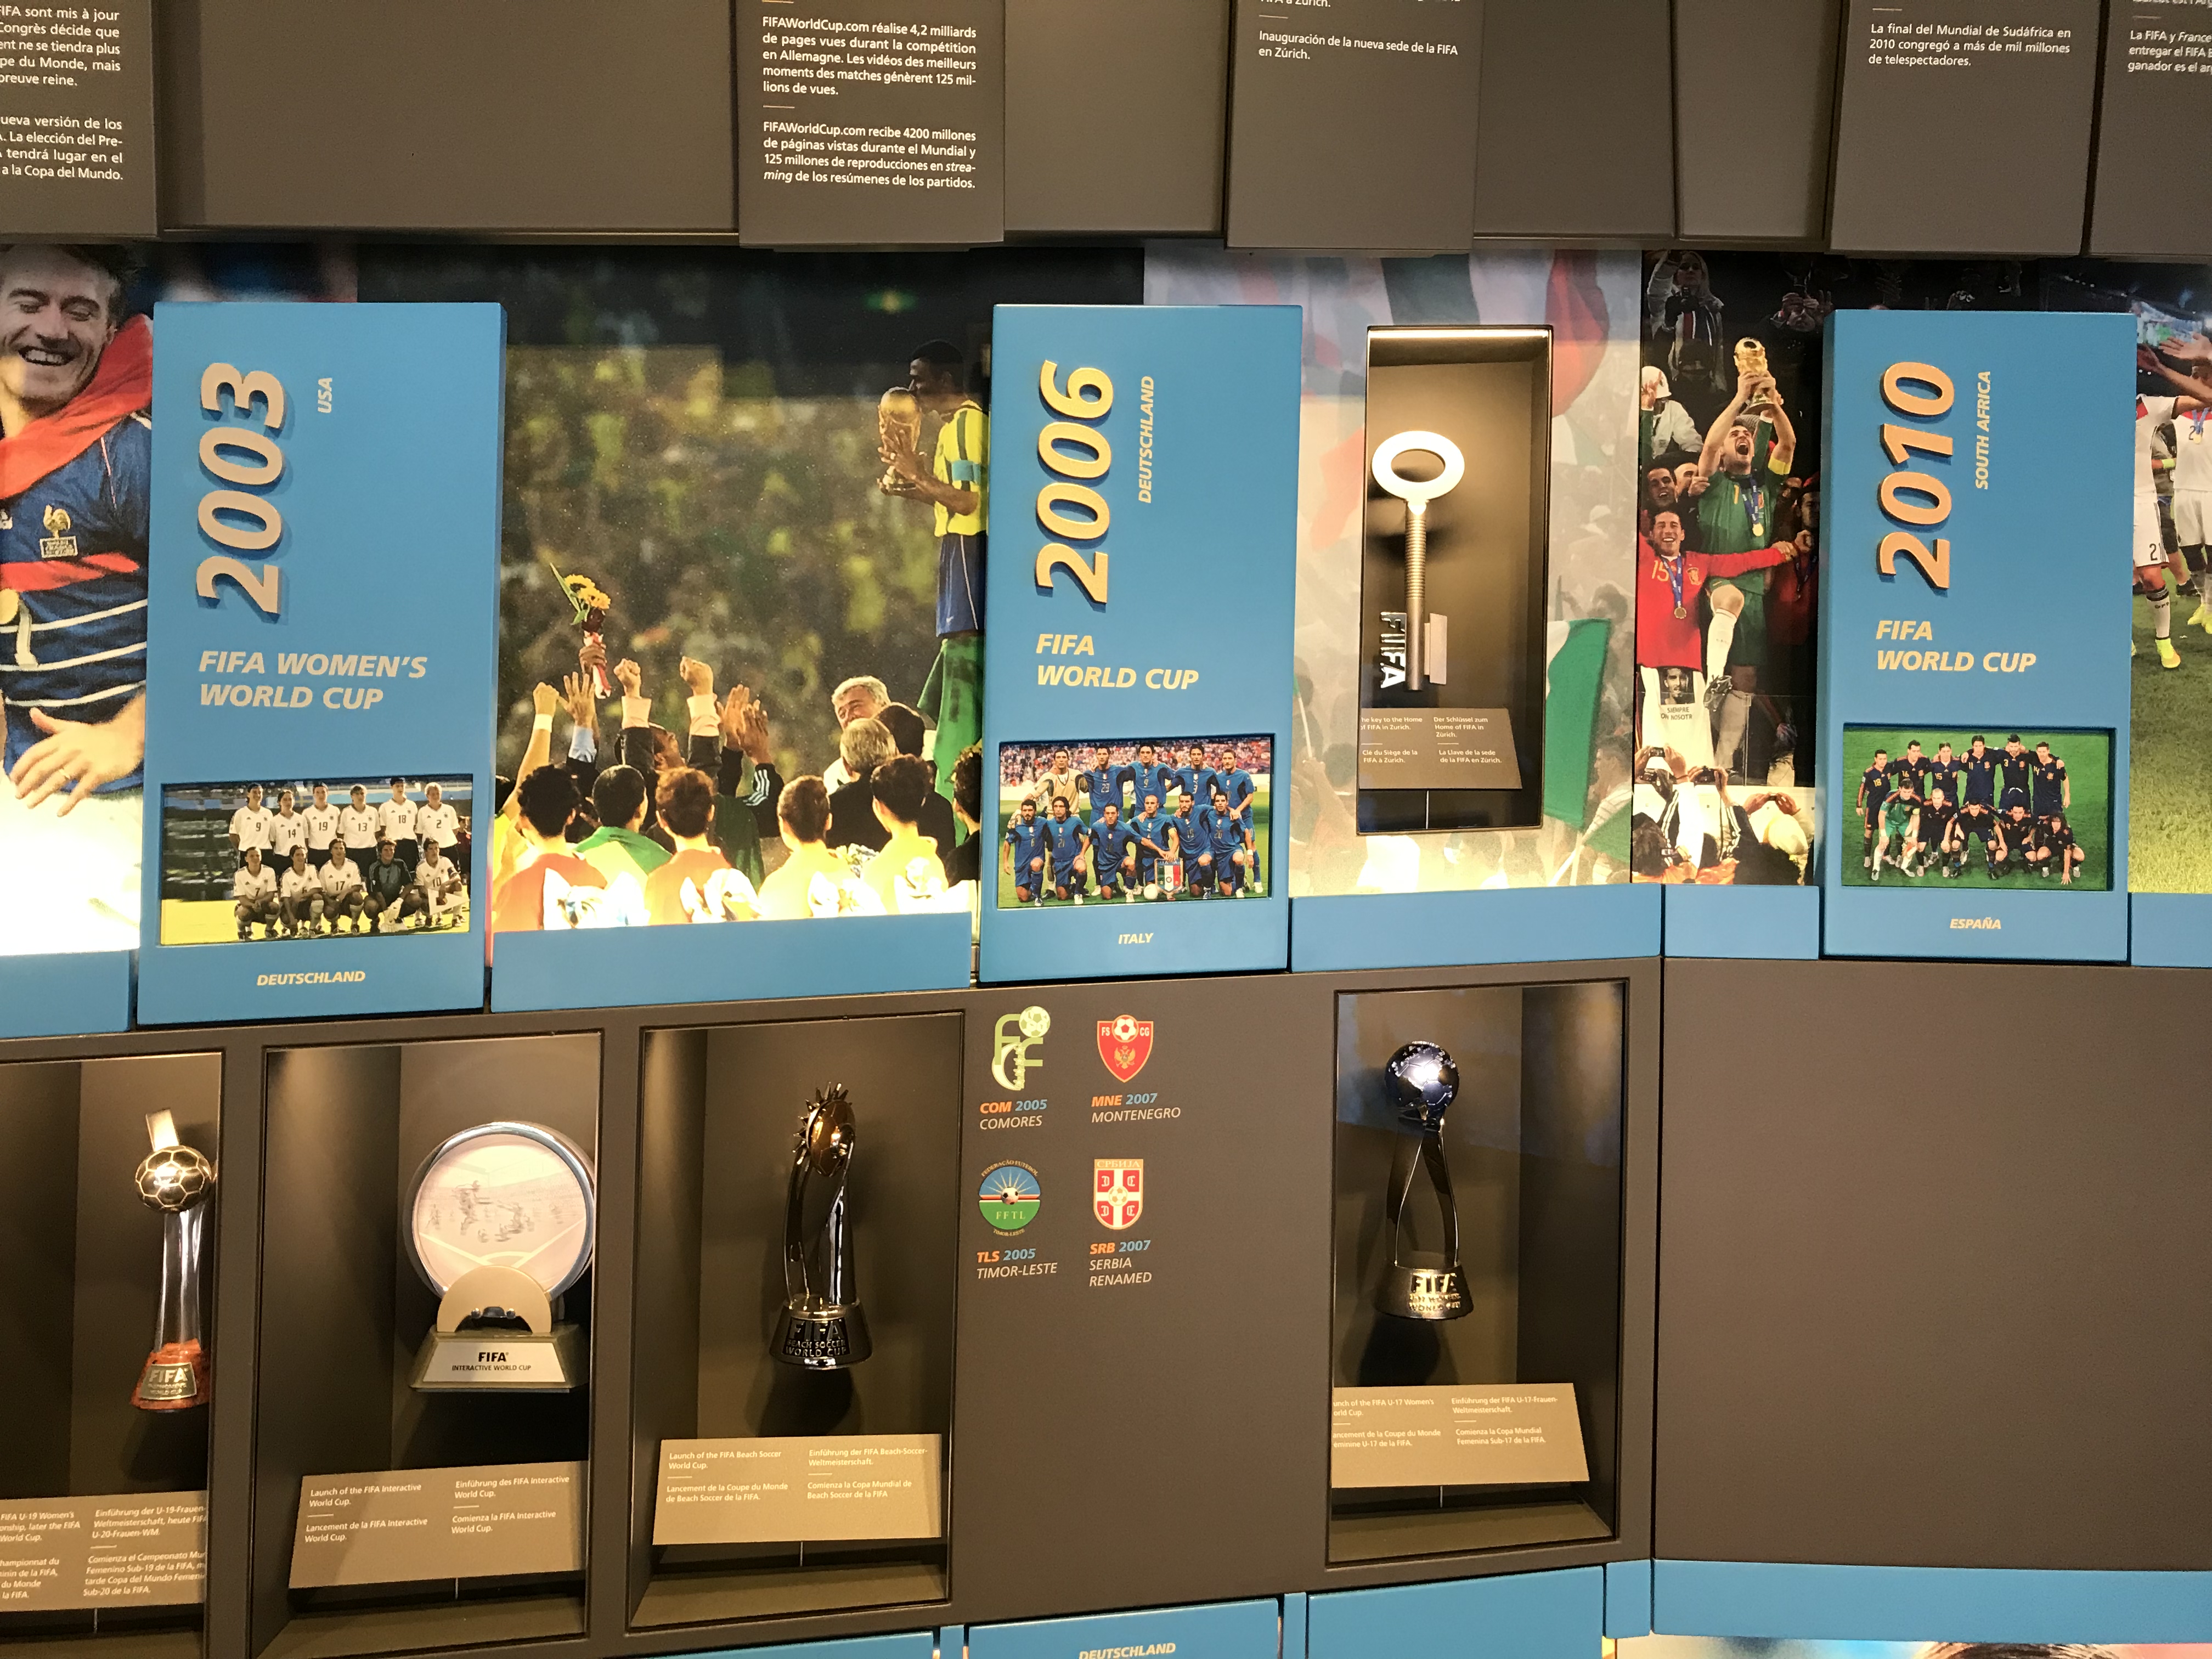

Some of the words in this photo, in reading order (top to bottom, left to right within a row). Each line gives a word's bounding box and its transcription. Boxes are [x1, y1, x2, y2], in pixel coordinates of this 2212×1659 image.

[1871, 24, 1883, 33] La
[1887, 23, 1912, 33] final
[1916, 24, 1933, 35] del
[1937, 25, 1982, 35] Mundial
[1985, 26, 1999, 36] de
[2003, 26, 2053, 37] Sudáfrica
[1260, 31, 1325, 45] Inauguración
[1328, 36, 1340, 46] de
[1343, 36, 1351, 47] la
[1354, 40, 1384, 49] nueva
[1386, 41, 1409, 51] sede
[1411, 42, 1424, 53] de
[1426, 43, 1435, 53] la
[1437, 44, 1458, 55] FIFA
[1870, 39, 1895, 49] 2010
[1898, 40, 1950, 52] congregó
[1964, 41, 1985, 50] más
[1988, 41, 2002, 51] de
[2006, 42, 2022, 52] mil
[2025, 42, 2070, 53] millones
[1259, 48, 1272, 57] en
[1274, 47, 1310, 59] Zúrich.
[1869, 54, 1882, 64] de
[1885, 54, 1971, 66] telespectadores.
[35, 116, 80, 128] versión
[84, 117, 100, 129] de
[105, 118, 122, 129] los
[10, 131, 23, 142] La
[26, 132, 74, 144] elección
[77, 134, 95, 145] del
[99, 135, 122, 146] Pre-
[764, 121, 866, 137] FIFAWorldCup.com
[868, 126, 901, 138] recibe
[903, 128, 929, 139] 4200
[932, 129, 976, 141] millones
[6, 148, 48, 160] tendrá
[54, 149, 87, 163] lugar
[91, 154, 106, 162] en
[111, 153, 122, 163] el
[763, 137, 778, 148] de
[781, 138, 825, 151] páginas
[827, 140, 858, 151] vistas
[861, 141, 905, 154] durante
[908, 144, 917, 154] el
[921, 144, 966, 156] Mundial
[969, 149, 976, 159] y
[765, 154, 782, 164] 125
[785, 154, 829, 166] millones
[831, 156, 845, 167] de
[848, 158, 928, 170] reproducciones
[945, 162, 975, 172] strea-
[12, 164, 21, 175] la
[25, 165, 54, 179] Copa
[57, 166, 75, 178] del
[78, 167, 123, 180] Mundo.
[764, 170, 793, 183] ming
[795, 171, 809, 181] de
[812, 171, 828, 182] los
[831, 173, 890, 184] resúmenes
[892, 174, 906, 185] de
[909, 175, 924, 186] los
[927, 177, 975, 189] partidos.
[318, 377, 332, 413] USA
[1977, 371, 1991, 432] AFRICA
[1139, 376, 1154, 503] DEUTSCHLAND
[1976, 432, 1989, 490] SOUTH
[1035, 360, 1114, 605] 2006
[1877, 362, 1954, 589] 2010
[196, 362, 285, 617] 2003
[1651, 560, 1669, 581] 15
[1876, 620, 1932, 640] FIFA
[1036, 634, 1094, 656] FIFA
[1380, 612, 1407, 689] FIFA
[199, 651, 265, 674] FIFA
[278, 653, 428, 679] WOMEN'S
[1878, 650, 1974, 671] WORLD
[1983, 652, 2036, 672] CUP
[1038, 665, 1137, 687] WORLD
[1146, 669, 1199, 690] CUP
[201, 684, 313, 708] WORLD
[323, 687, 383, 709] CUP
[256, 822, 261, 831] 9
[319, 822, 328, 831] 19
[398, 815, 407, 823] 18
[436, 820, 442, 828] 2
[358, 823, 367, 831] 13
[336, 882, 345, 890] 17
[1950, 917, 2001, 929] ESPAÑA
[1119, 933, 1154, 944] ITALY
[257, 971, 365, 986] DEUTSCHLAND
[1102, 1027, 1110, 1036] FS
[1140, 1027, 1149, 1036] CG
[980, 1102, 1012, 1114] COM
[1015, 1099, 1047, 1111] 2005
[1091, 1095, 1122, 1107] MNE
[1126, 1093, 1158, 1104] 2007
[1092, 1107, 1181, 1122] MONTENEGRO
[980, 1115, 1042, 1130] COMORES
[1090, 1243, 1115, 1254] SRB
[1119, 1240, 1151, 1252] 2007
[977, 1251, 1000, 1263] TLS
[1003, 1249, 1036, 1261] 2005
[977, 1262, 1057, 1279] TIMOR-LESTE
[1090, 1257, 1132, 1271] SERBIA
[1090, 1272, 1152, 1286] RENAMED
[1411, 1273, 1457, 1293] FIFA
[790, 1319, 845, 1341] FIFA
[787, 1339, 811, 1348] BEACH
[478, 1352, 506, 1362] FIFA
[786, 1346, 821, 1357] WORLD
[827, 1347, 847, 1356] CUP
[149, 1368, 188, 1383] FIFA
[311, 1488, 337, 1497] Launch
[339, 1487, 348, 1495] of
[309, 1499, 333, 1507] World
[335, 1498, 351, 1506] Cup.
[1079, 1643, 1176, 1659] DEUTSCHLAND
